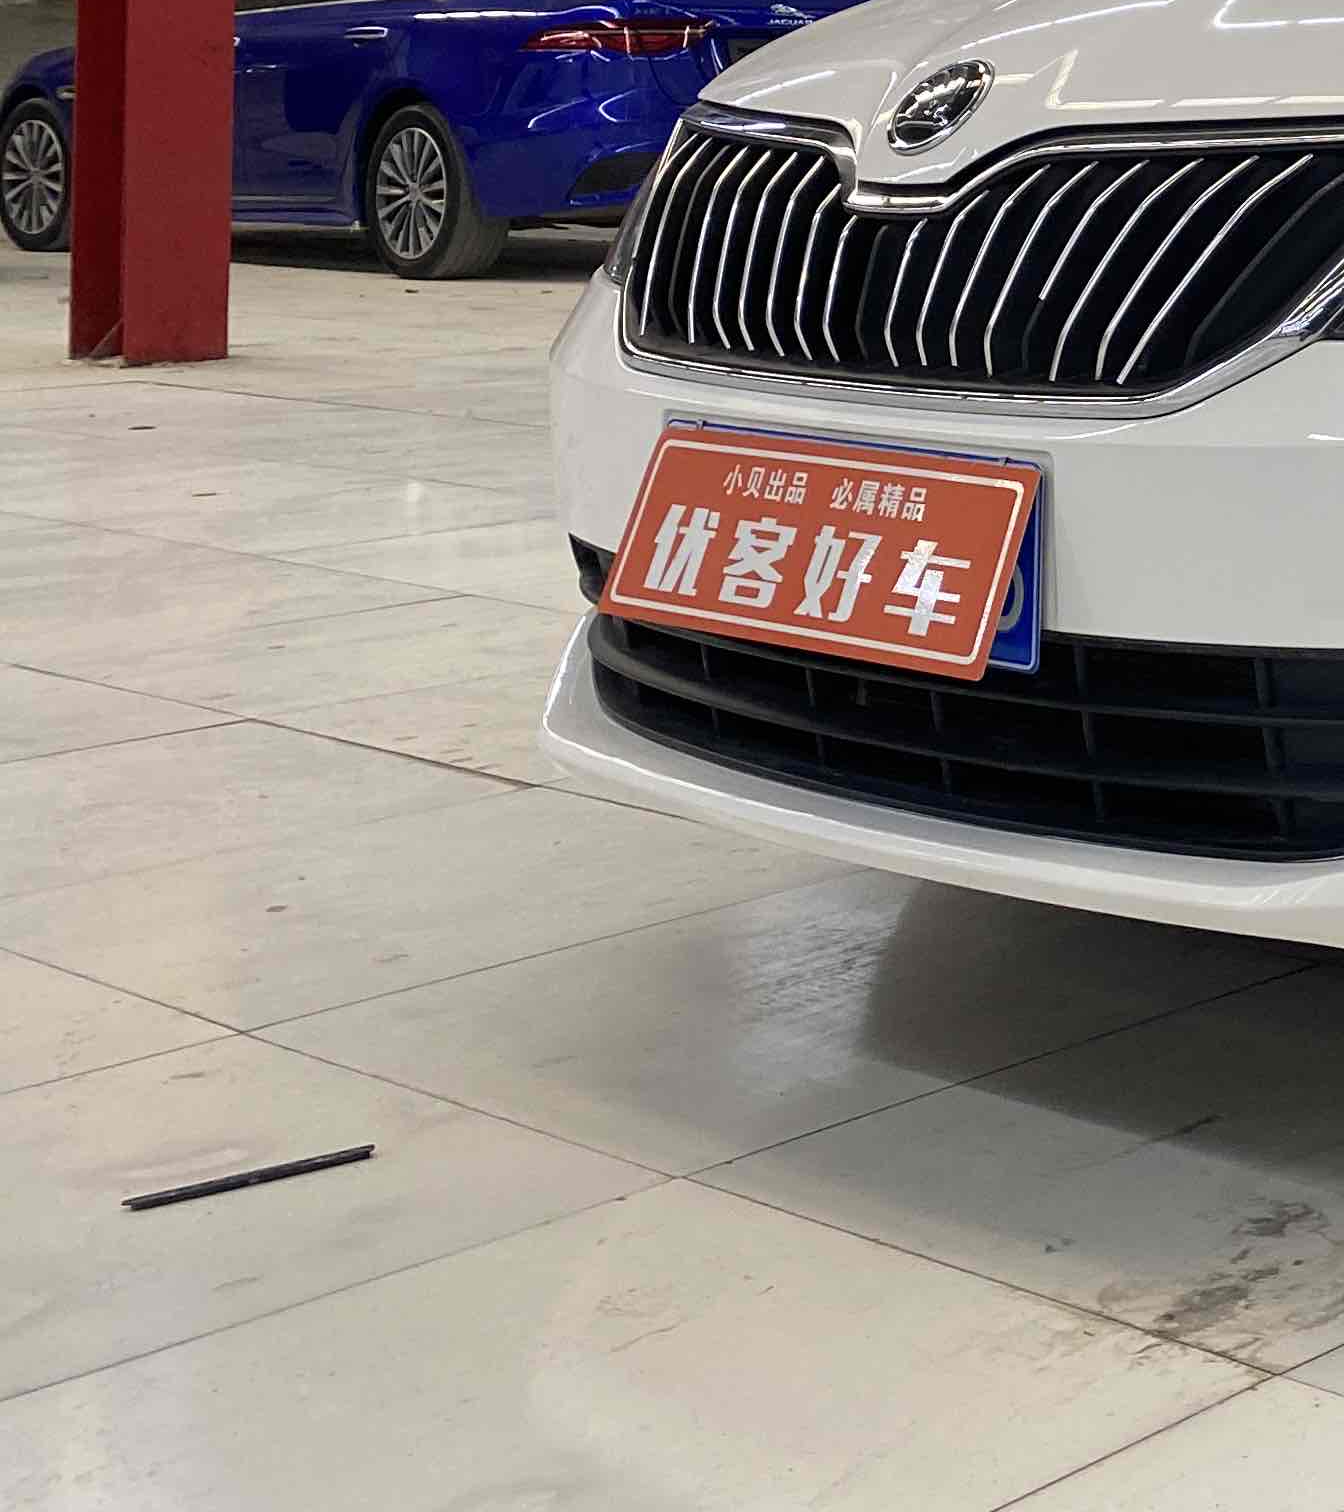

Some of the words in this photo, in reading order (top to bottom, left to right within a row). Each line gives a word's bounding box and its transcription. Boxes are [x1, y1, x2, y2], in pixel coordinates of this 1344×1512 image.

[722, 463, 809, 505] 小贝出品
[829, 477, 928, 522] 必属精品
[642, 503, 971, 637] 优客好车
